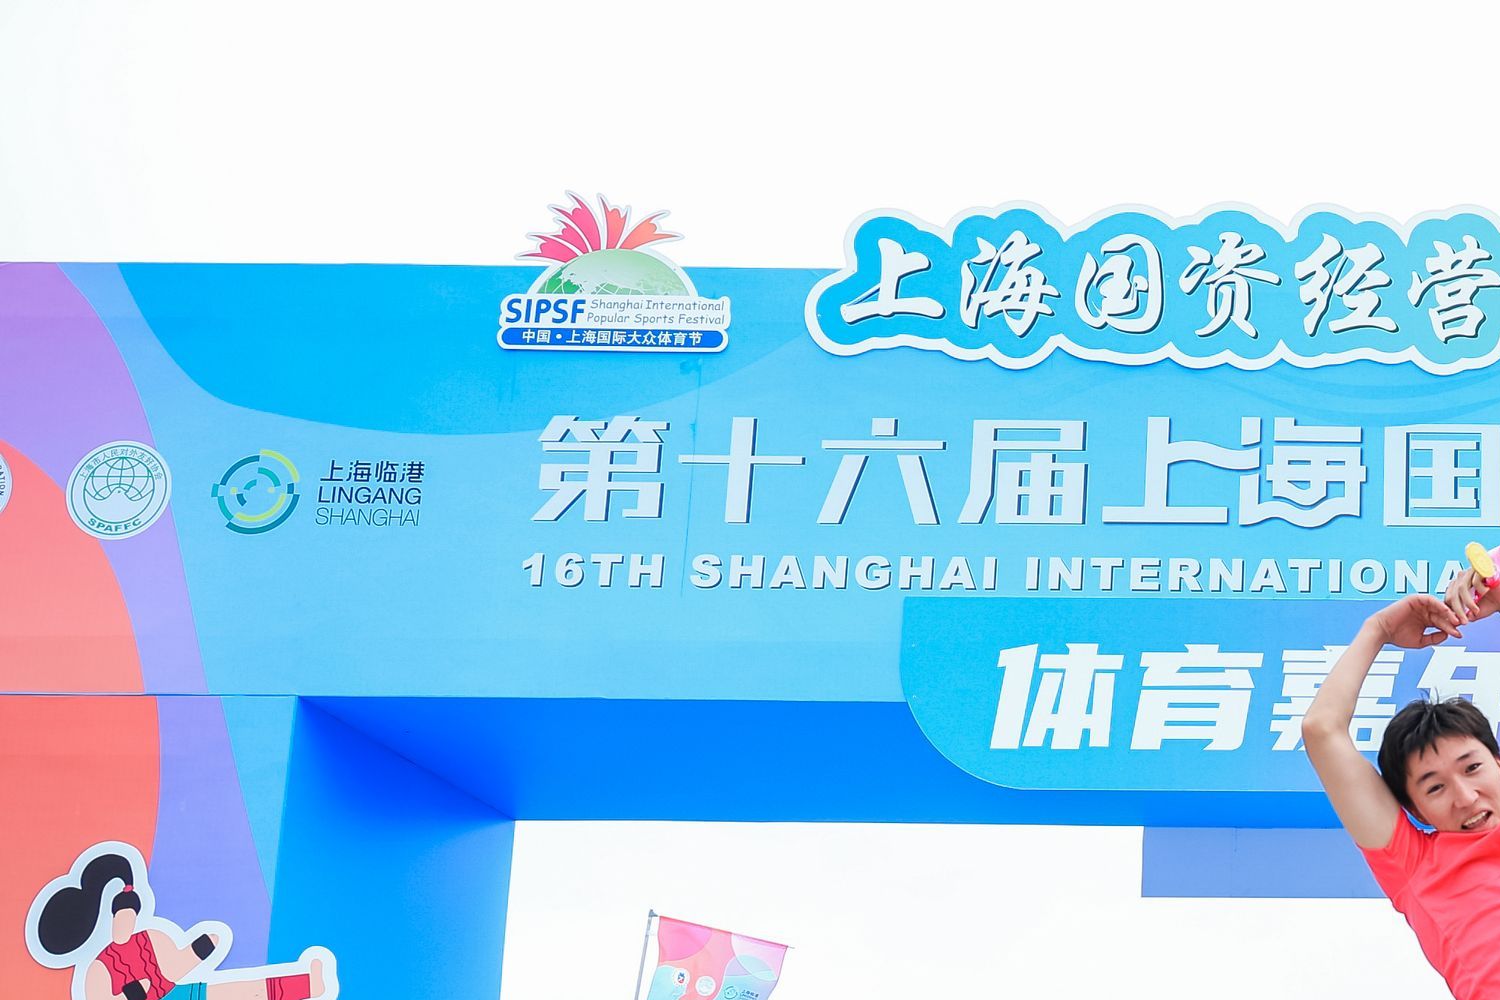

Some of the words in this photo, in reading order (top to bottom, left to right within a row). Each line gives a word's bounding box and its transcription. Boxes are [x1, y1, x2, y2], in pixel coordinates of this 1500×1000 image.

[505, 299, 586, 324] SIPSF
[590, 299, 644, 312] Shanghai
[646, 300, 724, 311] International
[587, 312, 630, 325] Popular
[634, 313, 674, 326] Sports
[678, 313, 724, 325] Festival
[320, 460, 425, 483] 上海临港
[317, 486, 422, 505] LINGANG
[87, 518, 143, 532] SPAFFC
[315, 507, 420, 527] SHANGHAI
[522, 552, 665, 588] 16TH
[689, 554, 998, 591] SHANGHAI
[1026, 556, 1464, 594] INTERNATIONA
